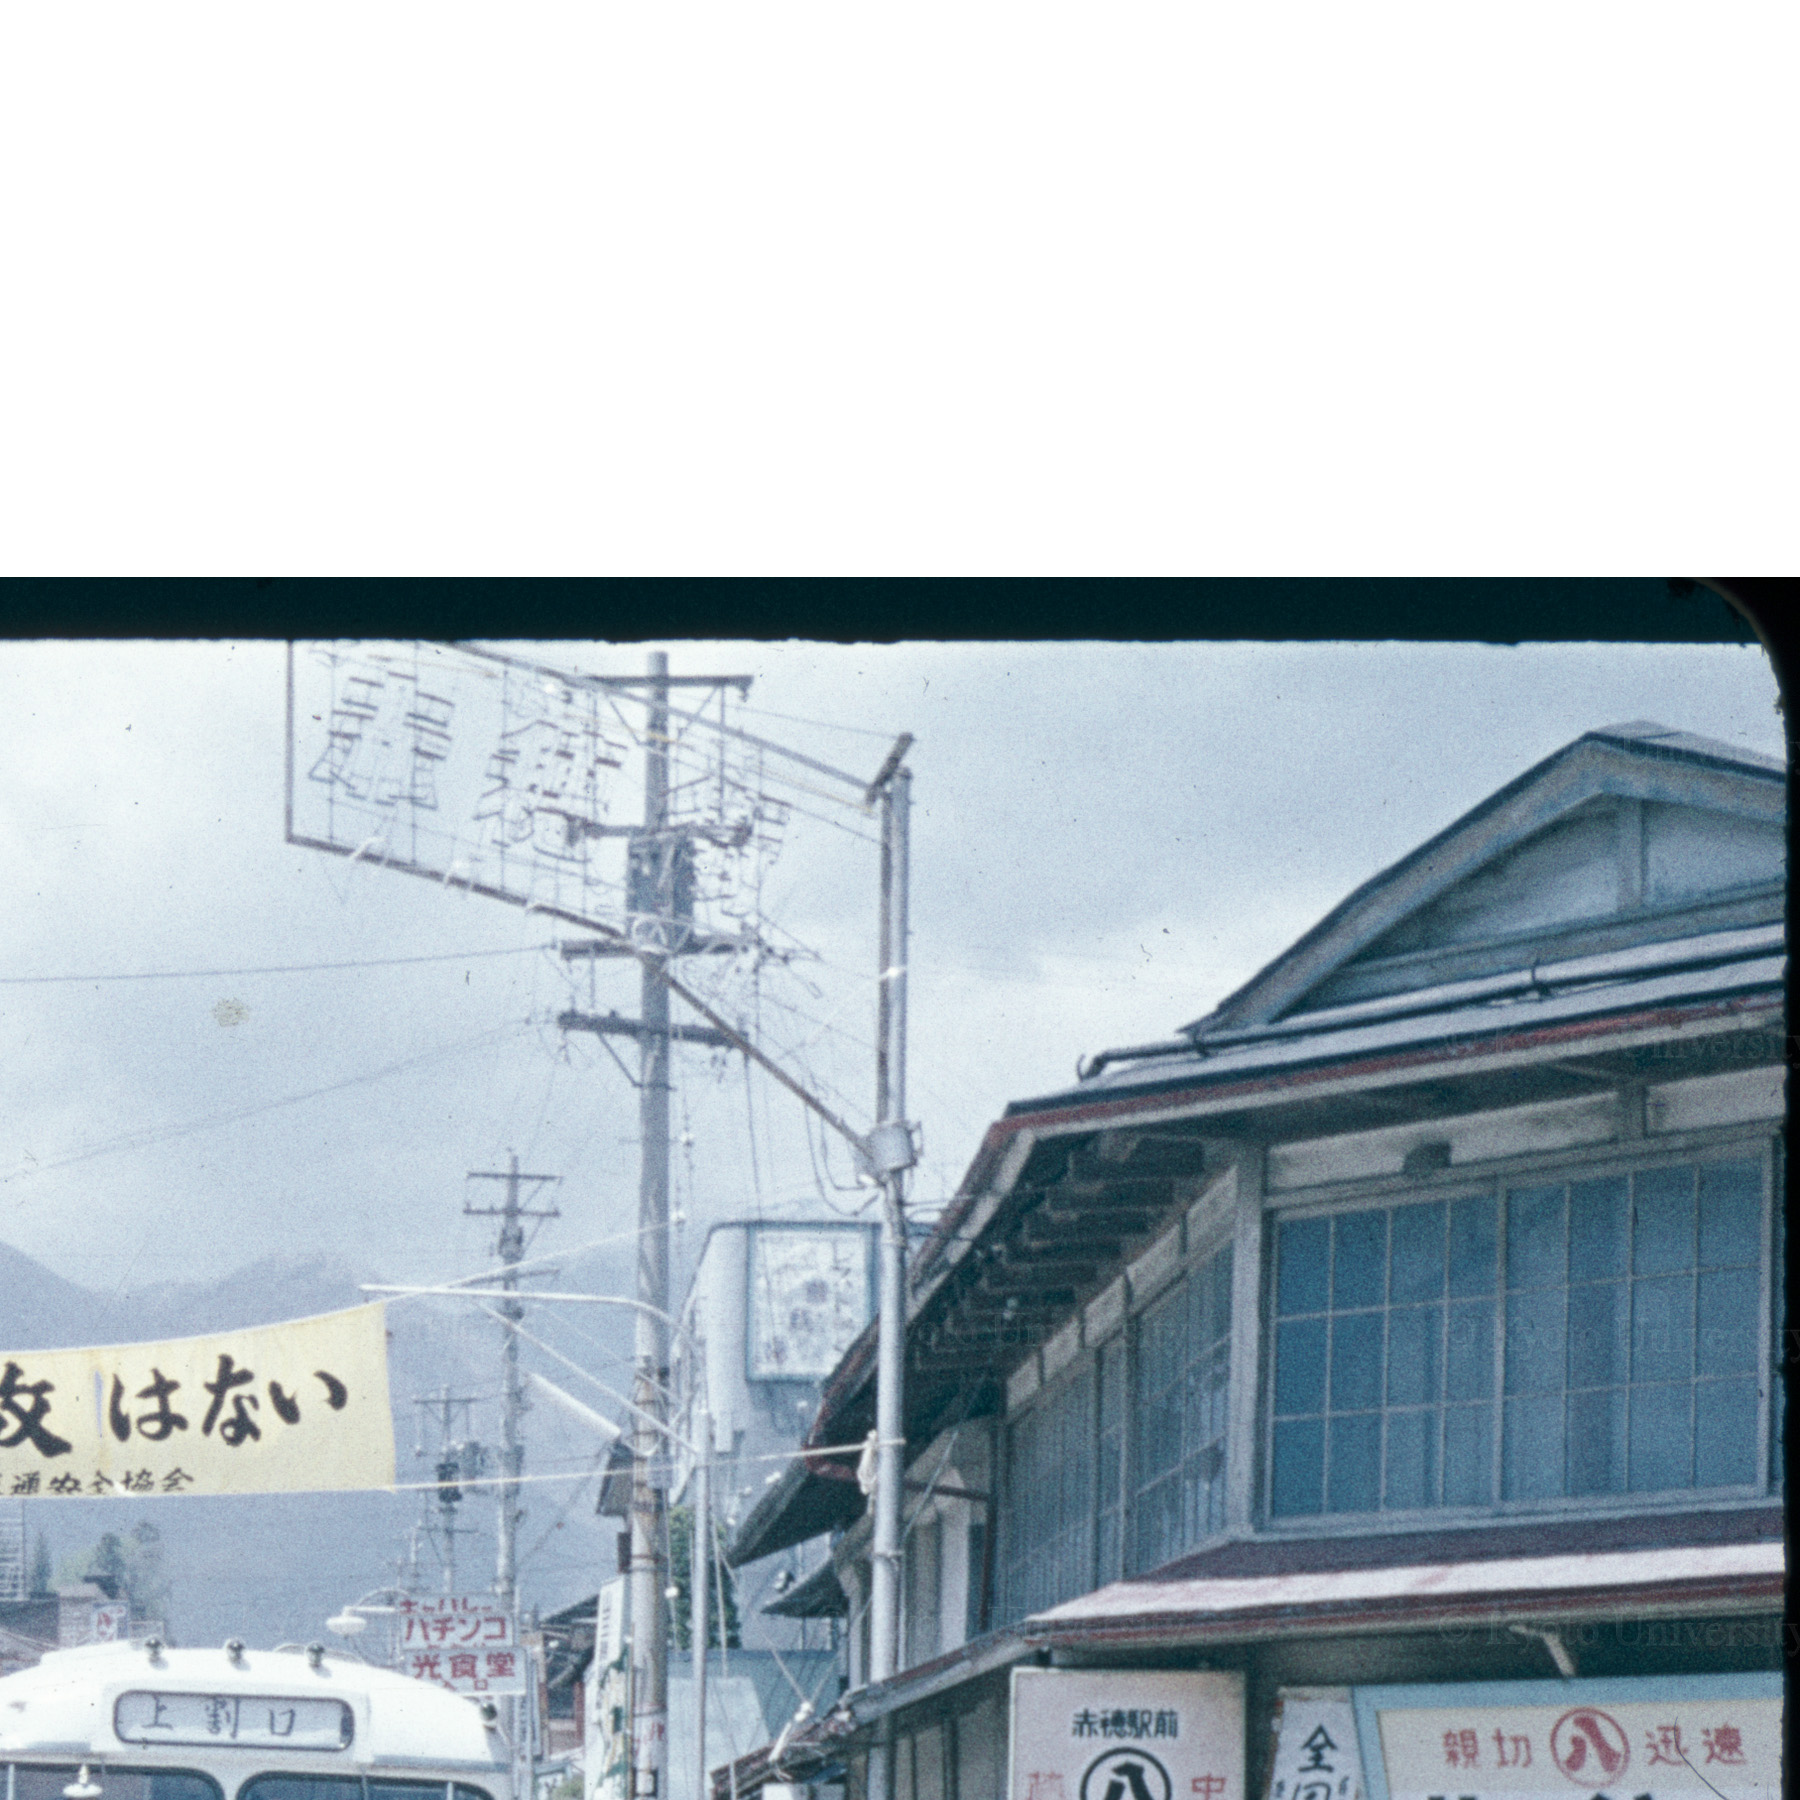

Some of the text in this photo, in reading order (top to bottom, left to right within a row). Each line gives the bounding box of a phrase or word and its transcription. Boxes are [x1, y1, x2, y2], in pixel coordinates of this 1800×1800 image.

[108, 1354, 347, 1448] はない
[412, 1652, 515, 1679] 光食堂
[1442, 1728, 1533, 1769] 親切
